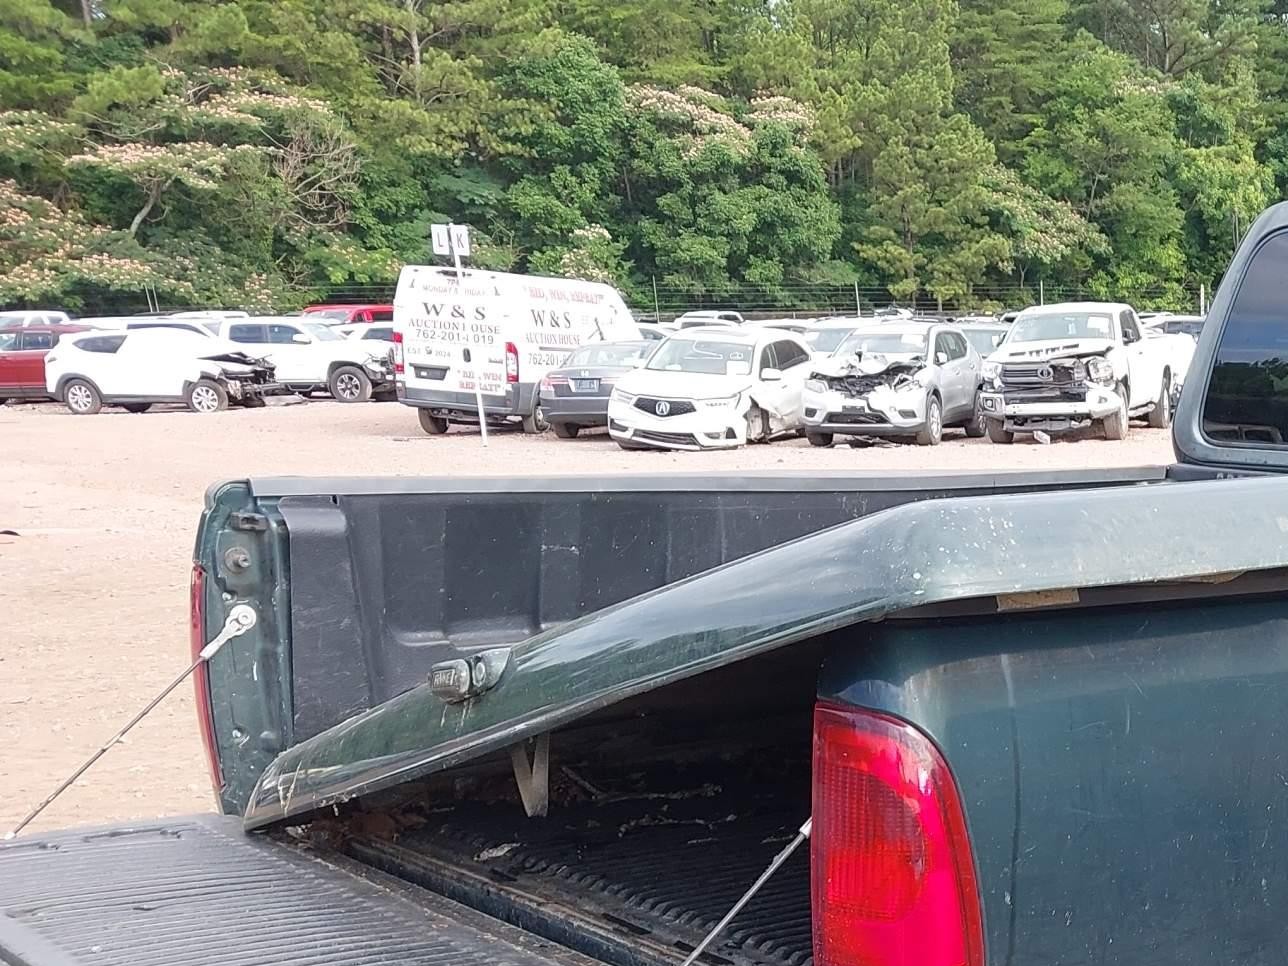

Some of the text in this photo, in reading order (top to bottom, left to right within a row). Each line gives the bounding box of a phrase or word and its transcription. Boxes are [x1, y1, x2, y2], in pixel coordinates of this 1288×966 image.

[437, 231, 444, 248] L
[456, 233, 464, 248] K
[422, 302, 486, 321] W & S
[531, 309, 571, 329] W & S
[408, 318, 459, 331] AUCTION
[416, 328, 495, 345] 762-201-019
[526, 331, 581, 345] AUCTION HOUSE
